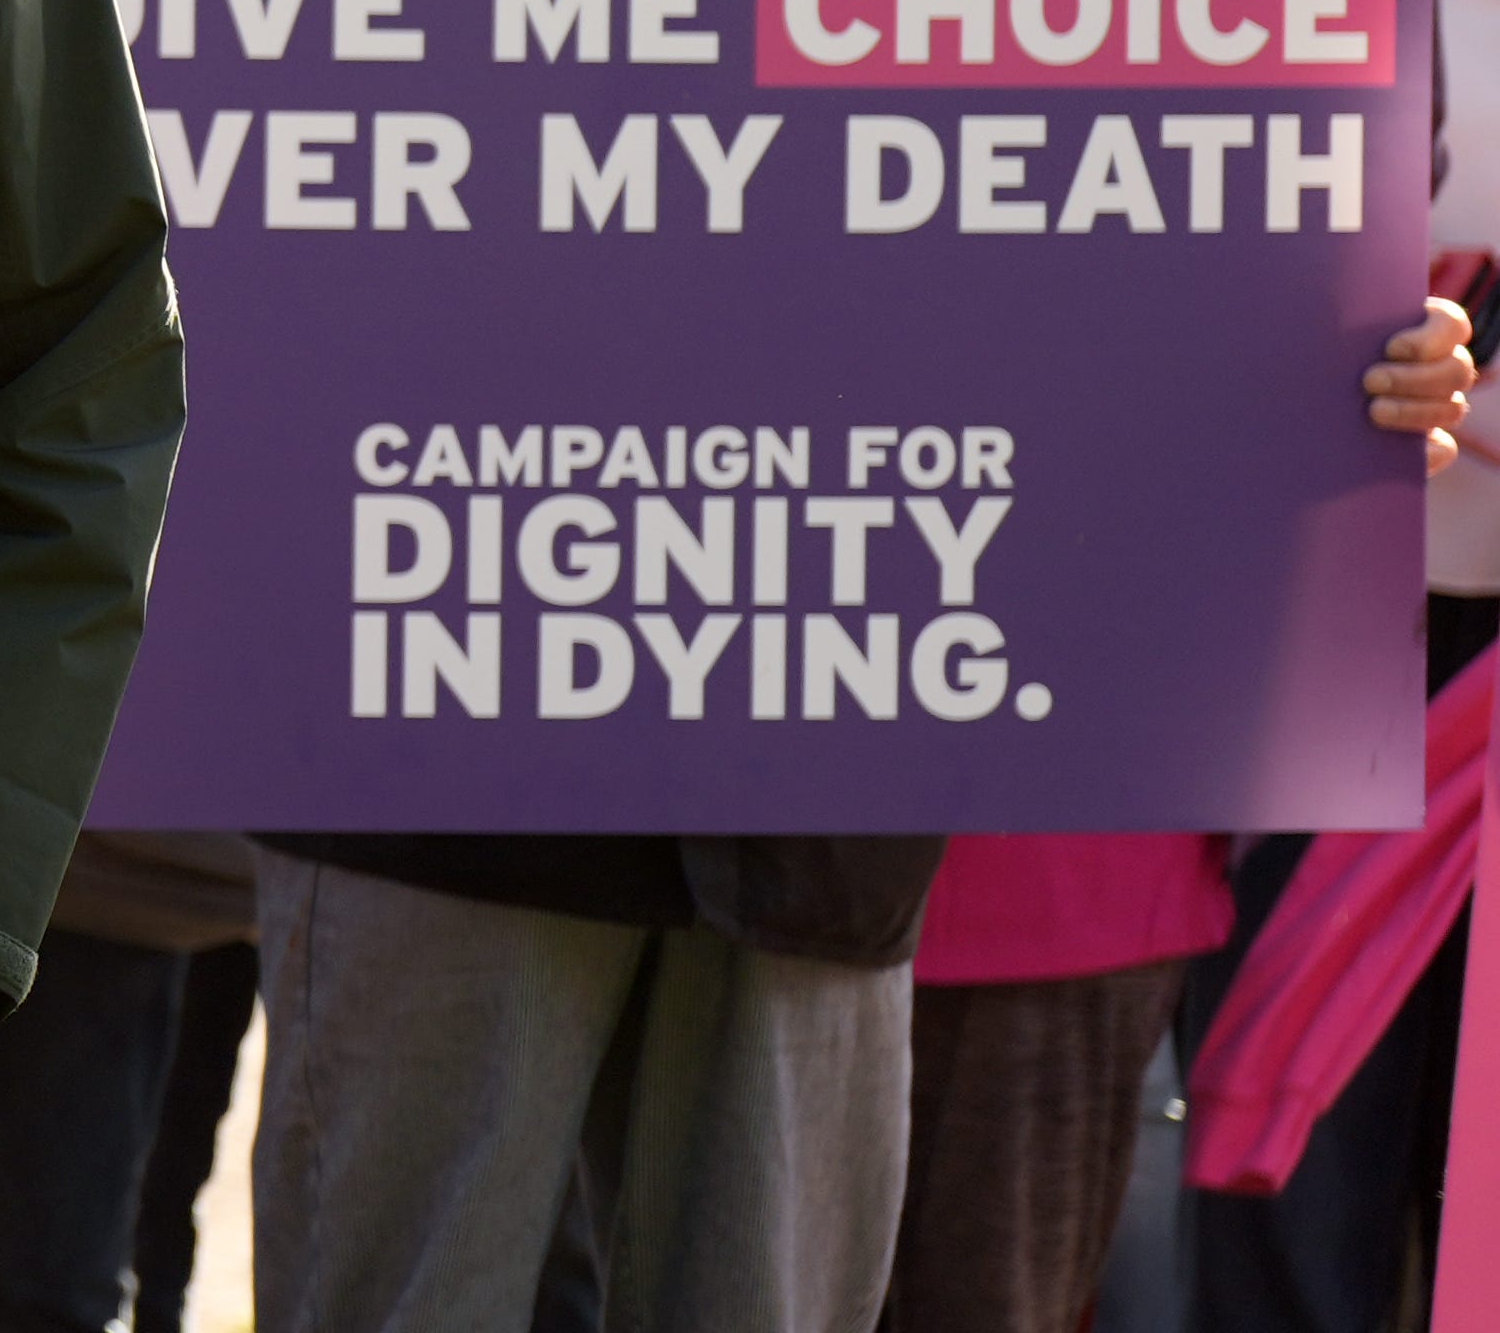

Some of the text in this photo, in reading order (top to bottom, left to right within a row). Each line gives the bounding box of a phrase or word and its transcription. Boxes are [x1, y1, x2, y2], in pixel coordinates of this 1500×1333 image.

[537, 112, 785, 234] MY
[843, 113, 1366, 235] DEATH
[352, 420, 1015, 491] CAMPAIGN FOR
[350, 491, 1014, 608] DIGNITY
[350, 609, 1053, 723] IN DYING.
